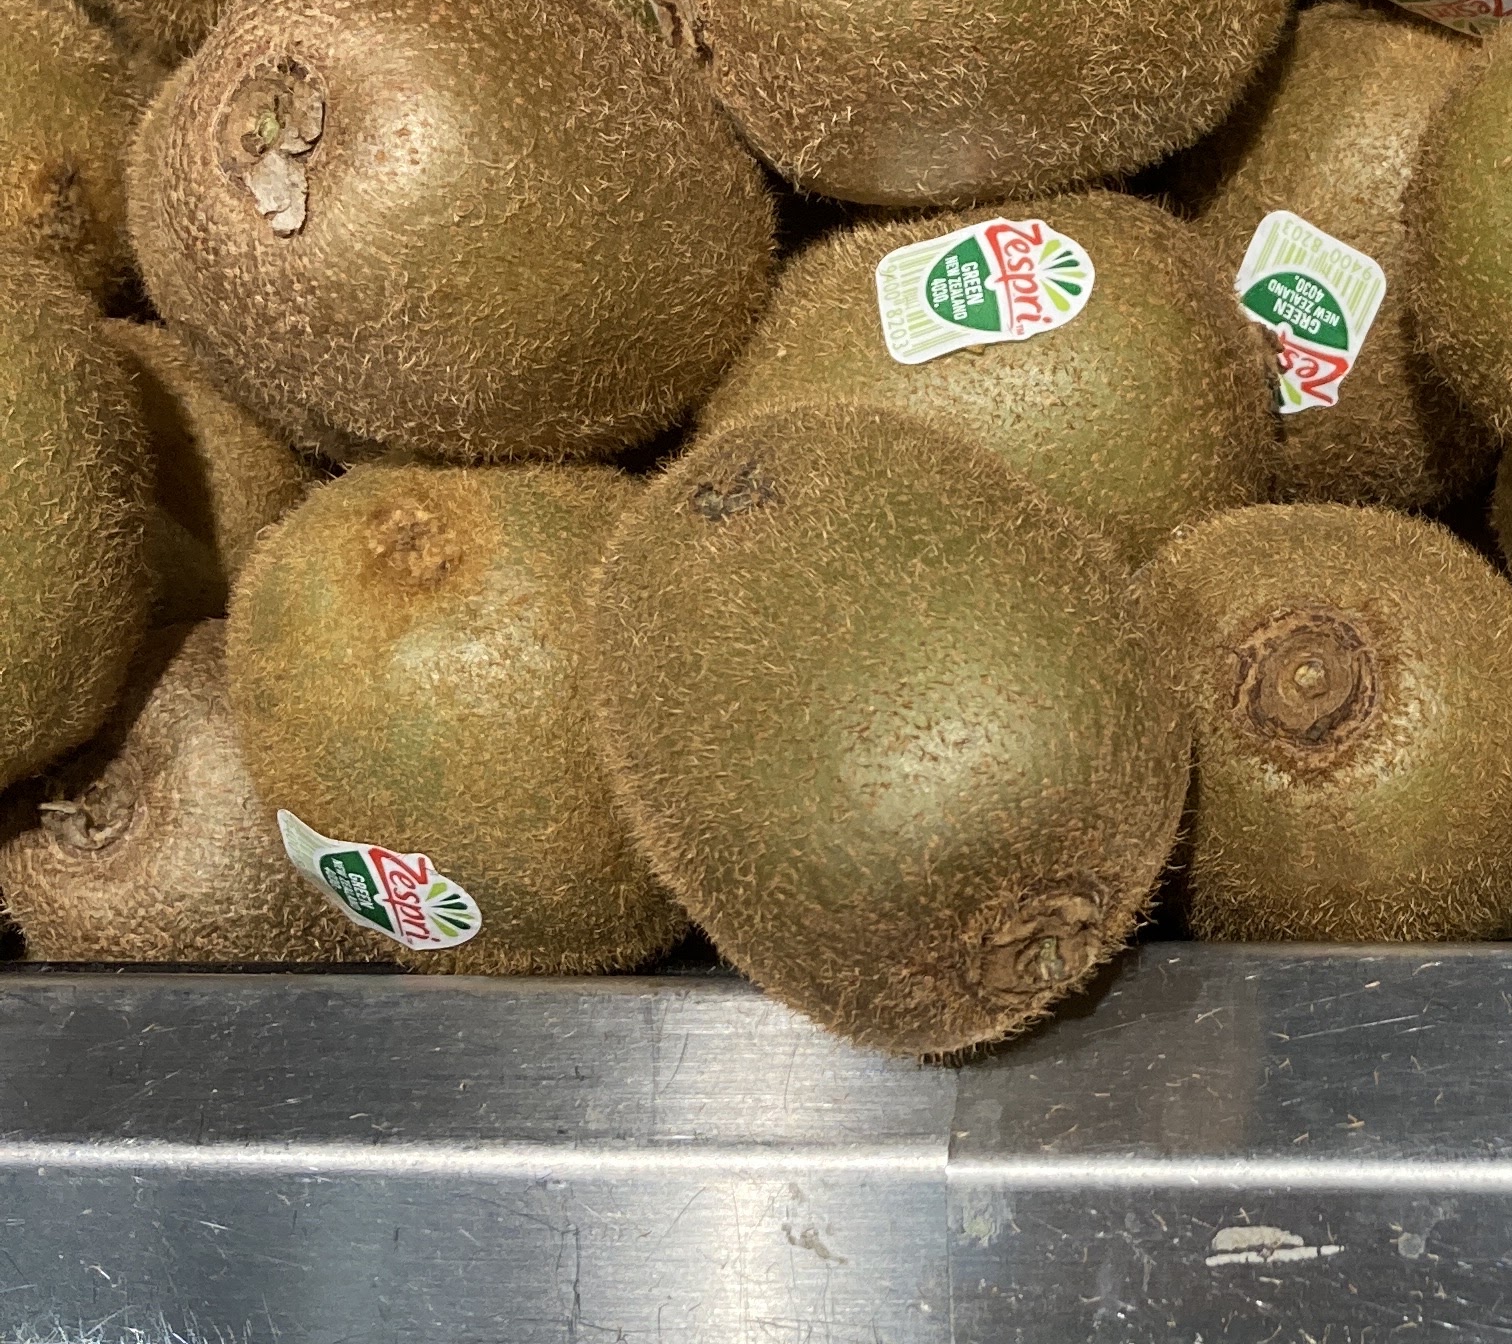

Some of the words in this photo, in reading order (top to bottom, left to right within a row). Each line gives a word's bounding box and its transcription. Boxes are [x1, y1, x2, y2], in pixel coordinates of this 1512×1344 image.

[944, 255, 962, 278] NEW
[960, 261, 984, 306] GREEN
[984, 223, 1053, 326] Zespri
[947, 276, 968, 321] ZEALAND
[1267, 278, 1315, 312] ZEALAND
[1272, 299, 1322, 335] GREEN
[1313, 304, 1340, 327] NEW
[368, 847, 441, 943] Zespri
